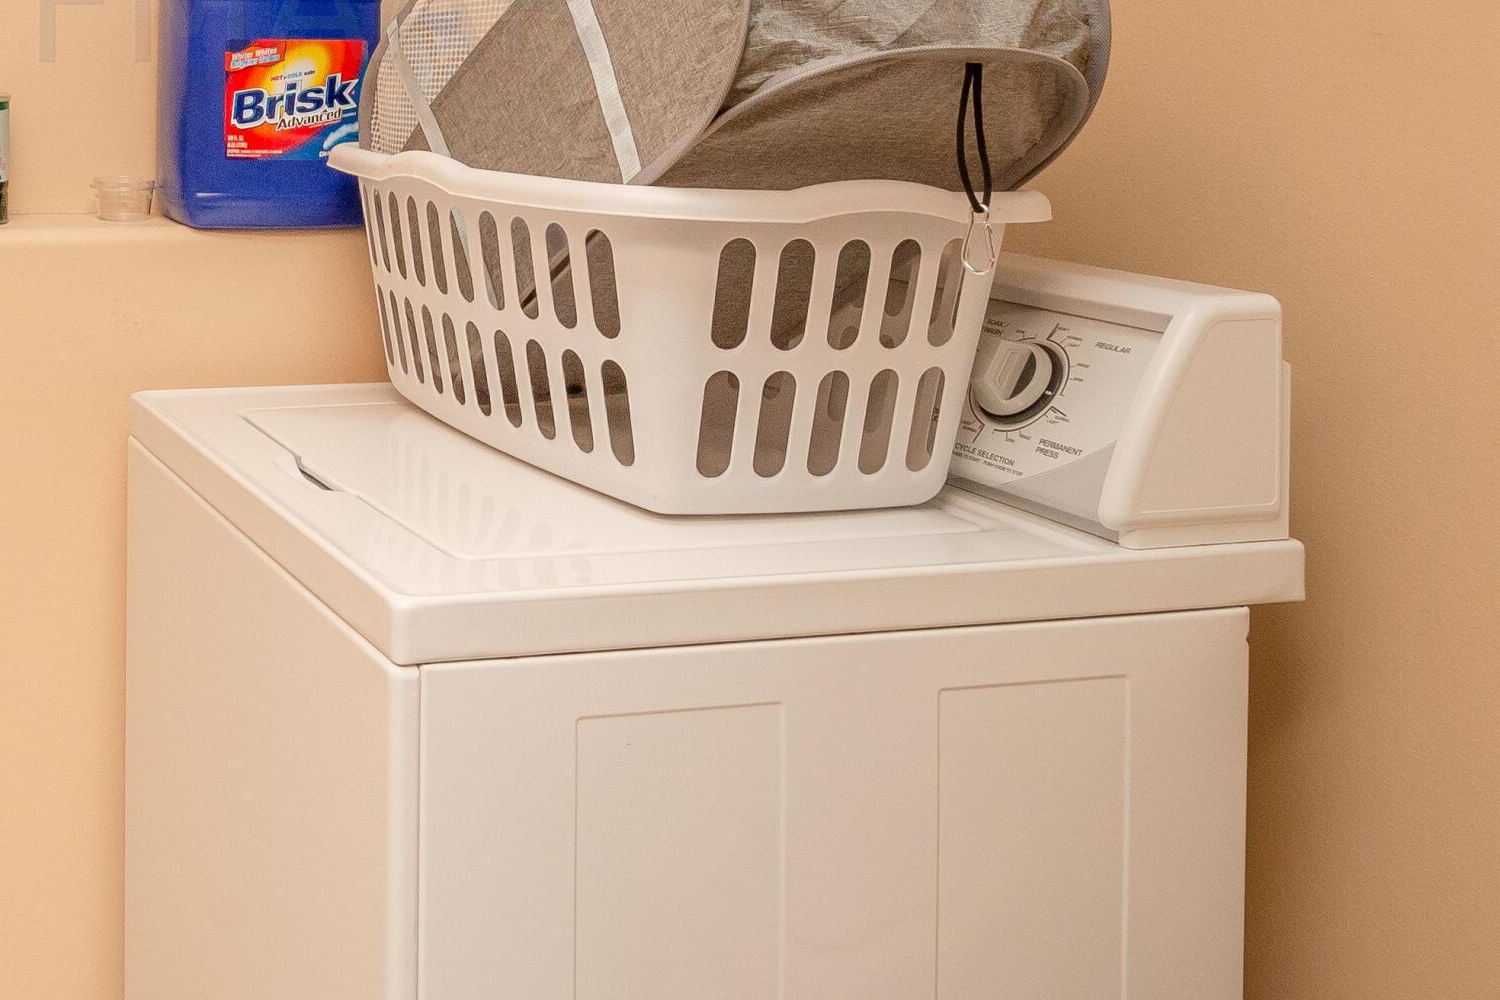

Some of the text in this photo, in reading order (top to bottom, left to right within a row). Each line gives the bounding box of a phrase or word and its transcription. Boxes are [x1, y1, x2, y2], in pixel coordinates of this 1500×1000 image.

[232, 73, 358, 128] Brisk
[276, 108, 343, 131] Advanced
[1094, 341, 1132, 355] REGULAR
[954, 442, 1015, 467] CYCLE SELECTION
[1035, 446, 1060, 460] PRESS
[1038, 438, 1083, 457] PERMANENT
